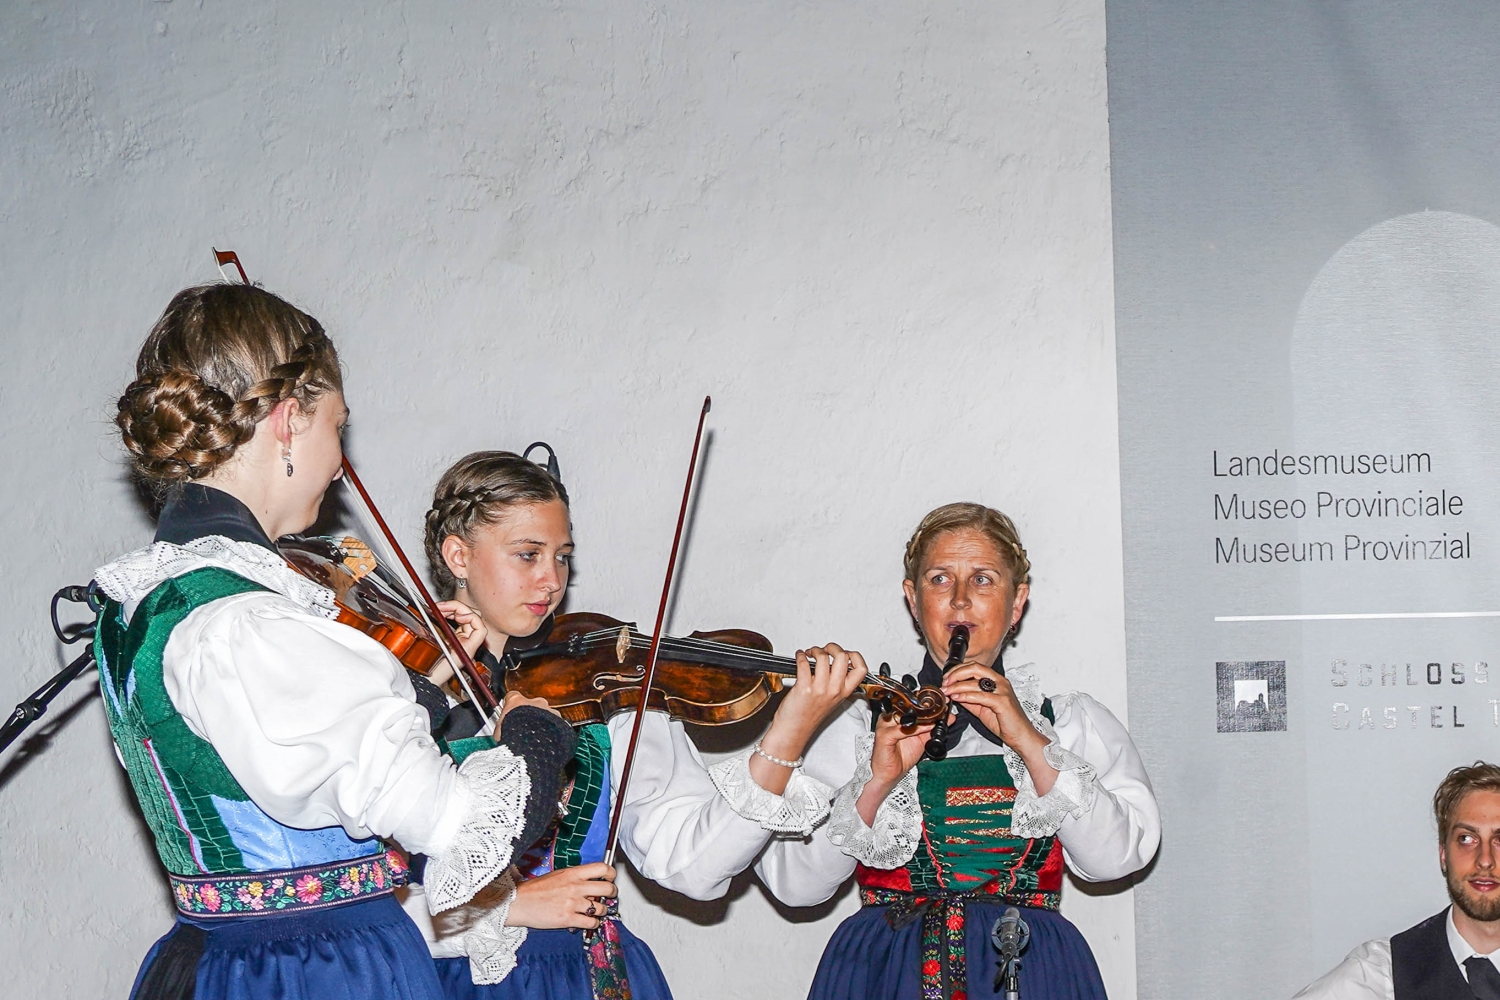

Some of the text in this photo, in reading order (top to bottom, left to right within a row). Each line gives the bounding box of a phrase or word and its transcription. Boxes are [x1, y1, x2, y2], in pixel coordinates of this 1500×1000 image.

[1213, 449, 1432, 477] Landesmuseum
[1214, 489, 1464, 520] Museo Provinciale
[1215, 532, 1471, 564] Museum Provinzial
